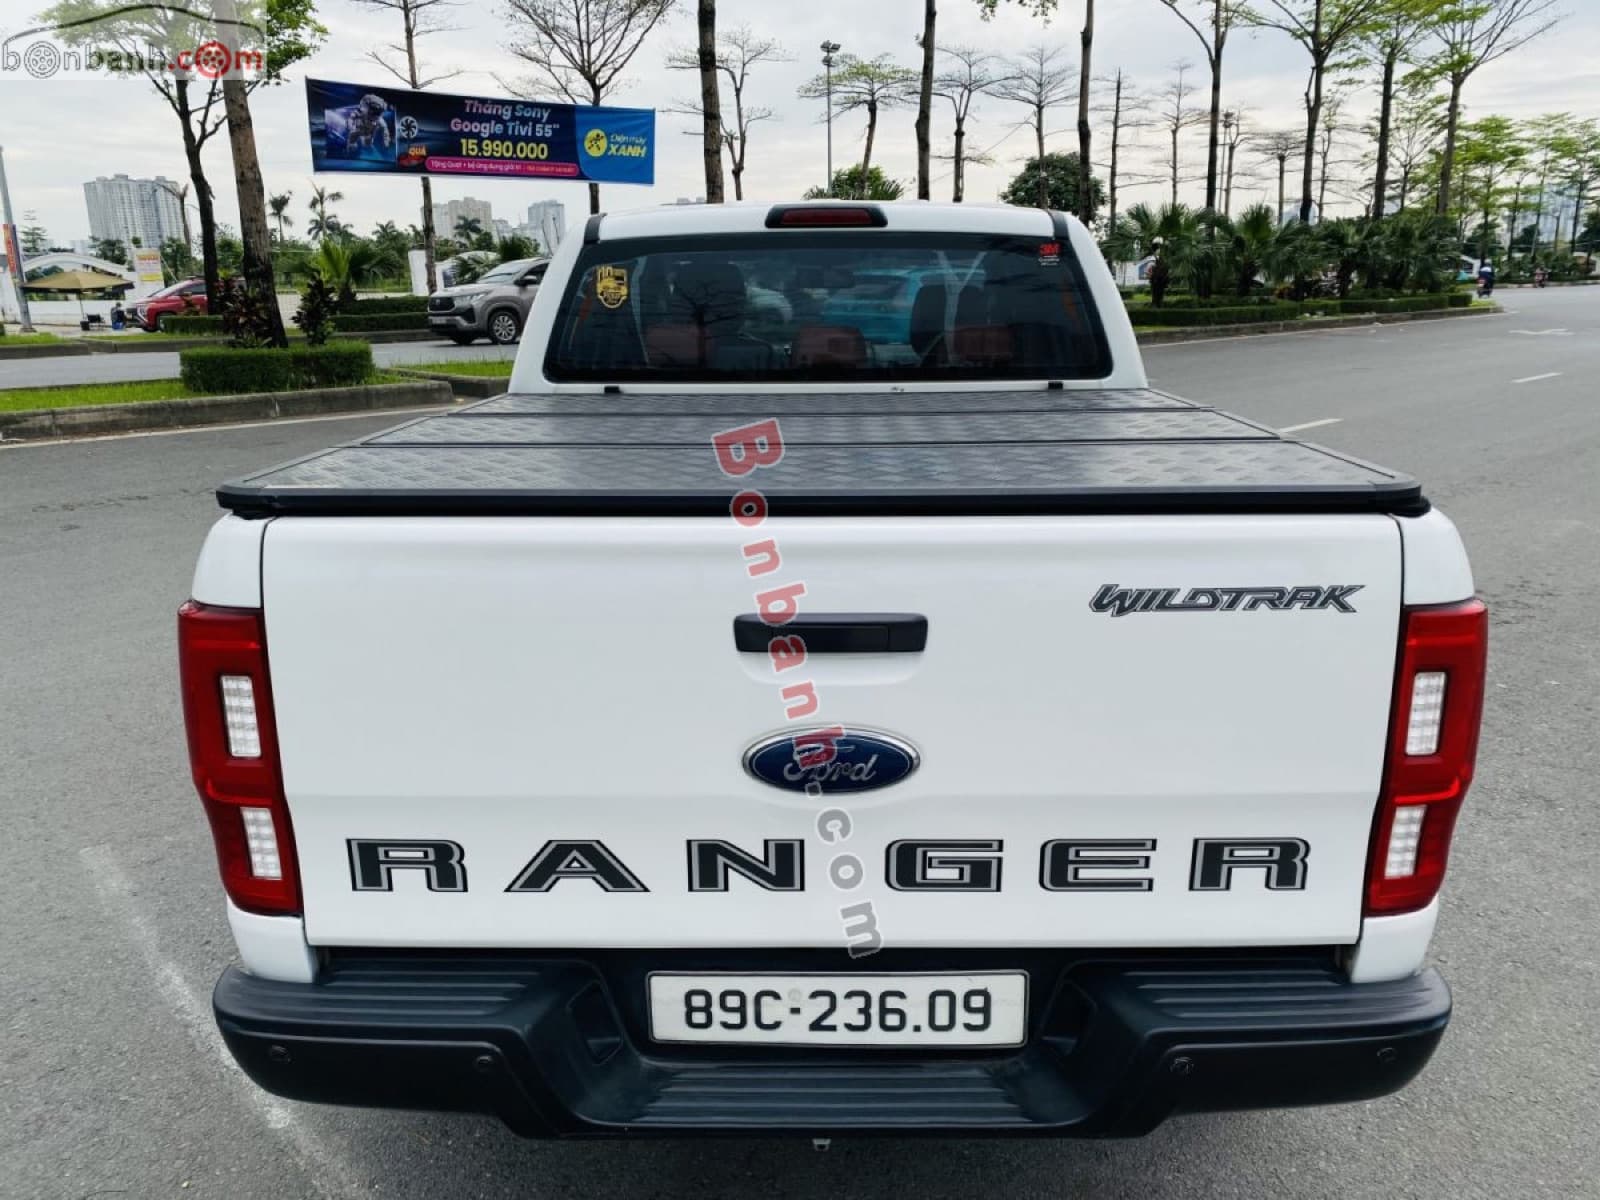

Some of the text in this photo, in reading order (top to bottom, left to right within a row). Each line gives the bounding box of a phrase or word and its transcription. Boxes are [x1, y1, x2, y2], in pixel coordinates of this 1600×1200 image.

[464, 99, 551, 122] Tháng Sony
[450, 118, 504, 138] Google
[506, 121, 533, 137] Tivi
[460, 138, 548, 159] 15.990.000
[608, 143, 648, 157] XANH
[1088, 584, 1366, 617] WILDTRAK
[783, 746, 880, 782] Ford
[345, 838, 1311, 892] RANGER
[684, 988, 993, 1033] 89C-236.09
